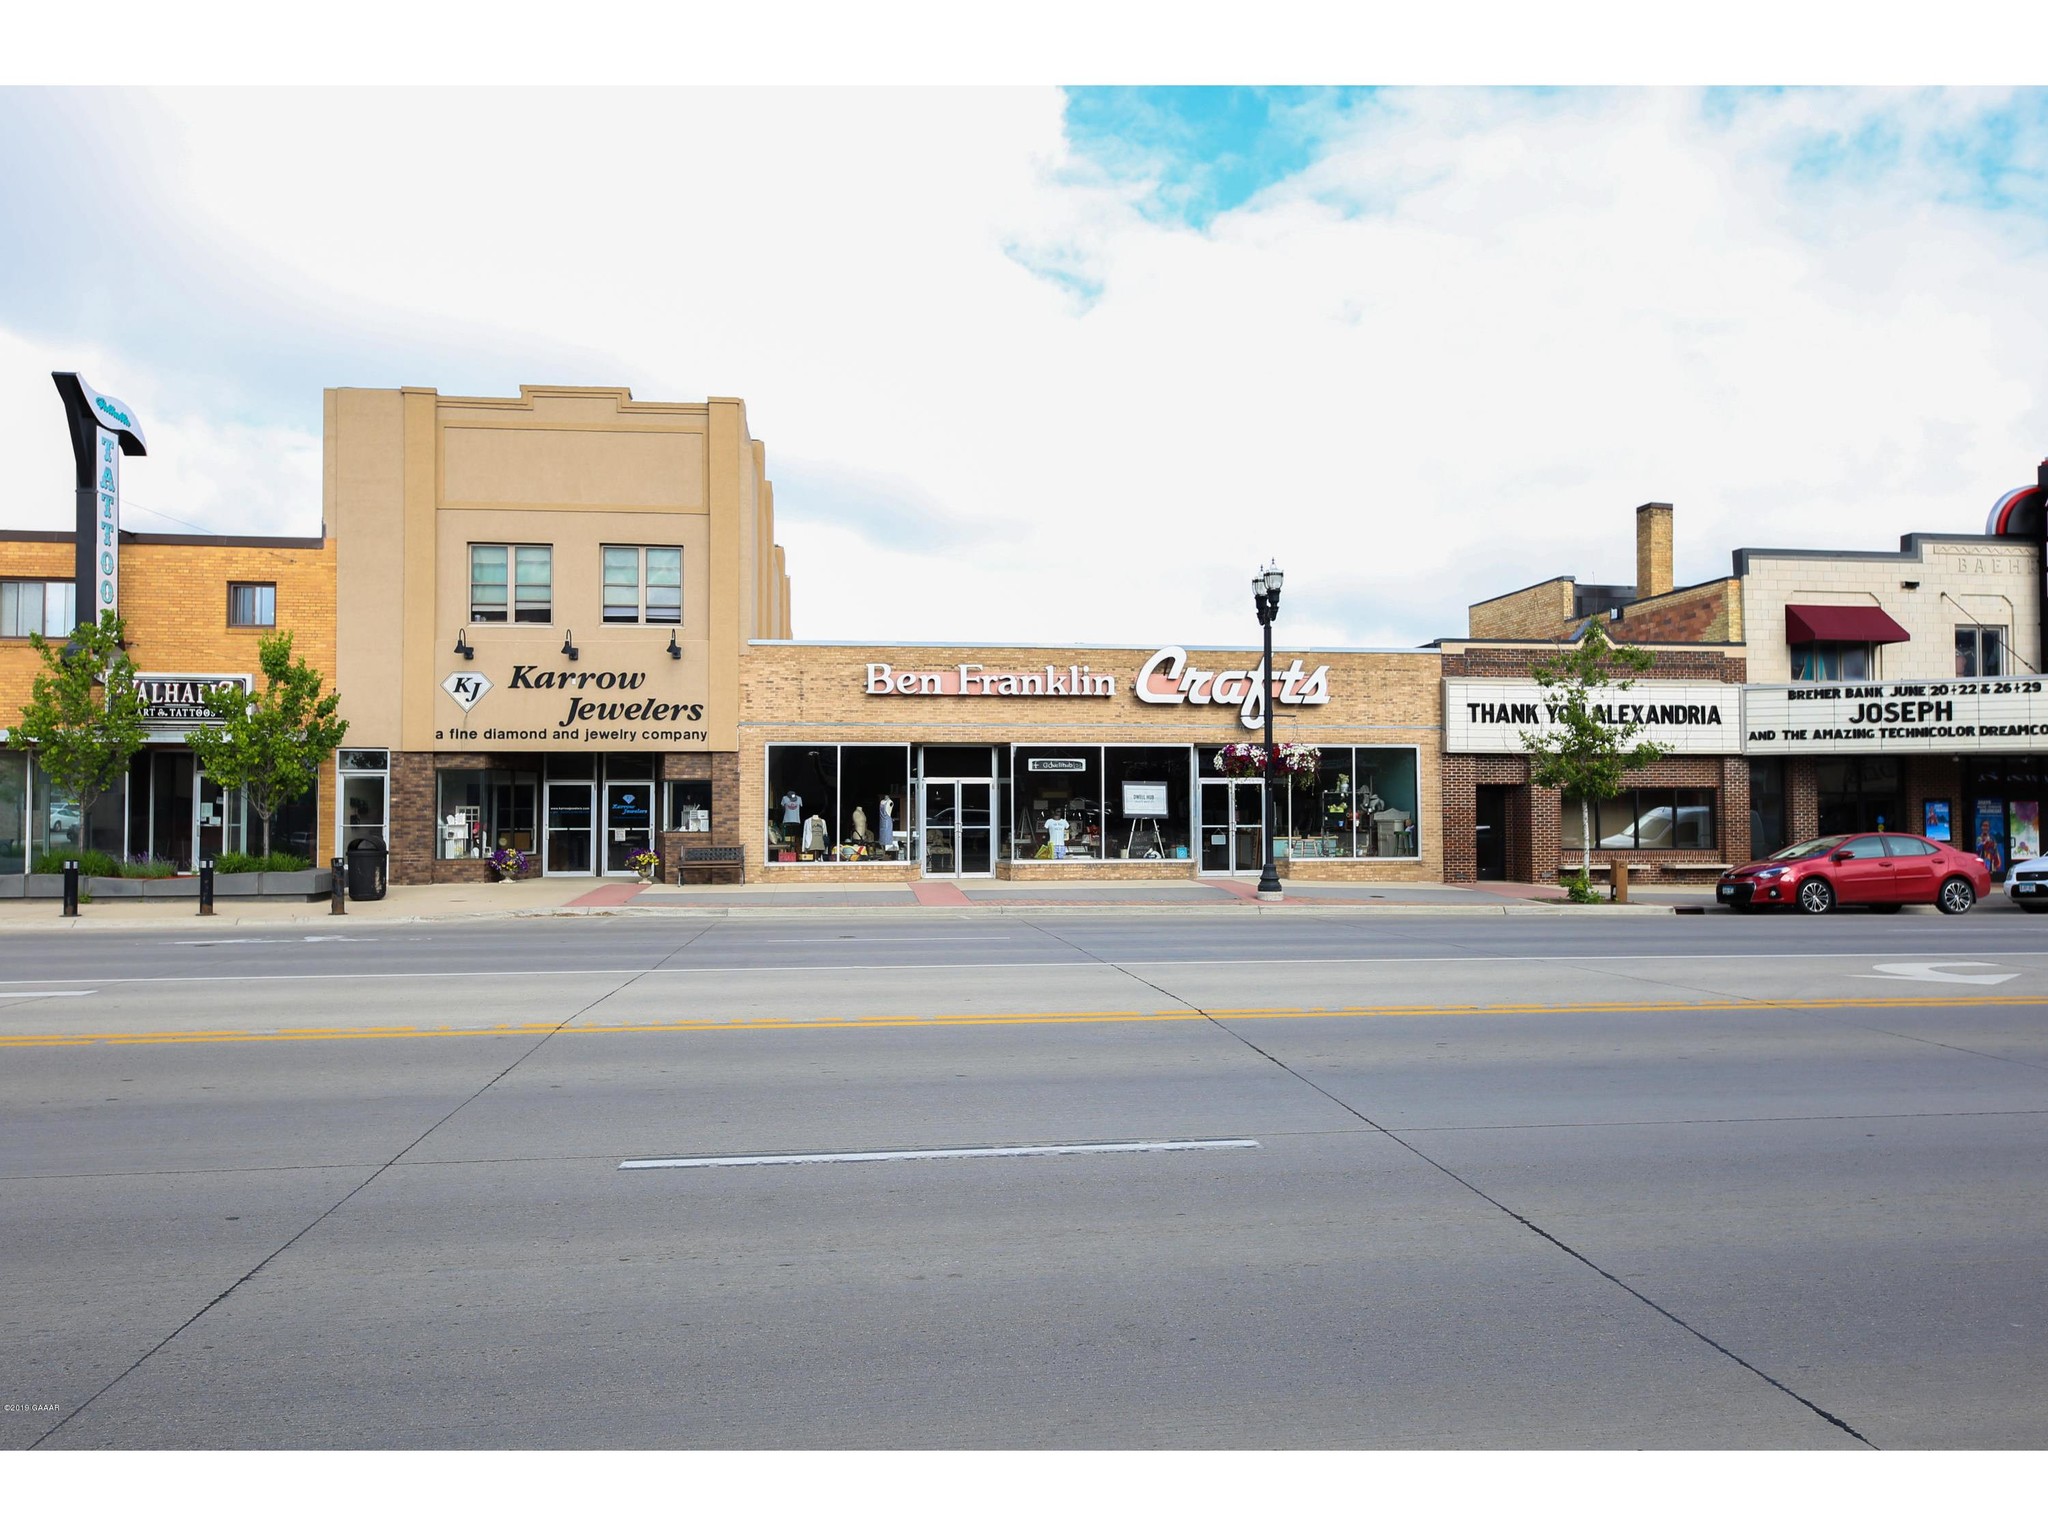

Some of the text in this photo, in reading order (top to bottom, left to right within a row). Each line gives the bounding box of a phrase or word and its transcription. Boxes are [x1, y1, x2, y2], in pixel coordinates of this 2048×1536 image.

[100, 436, 116, 605] TATTOO
[453, 677, 482, 703] KJ
[508, 665, 646, 690] Karrow
[865, 663, 1117, 697] Ben Franklin
[1135, 645, 1331, 730] Crafts
[1788, 688, 1841, 700] BREMER
[1845, 686, 1883, 698] BANK
[1890, 685, 1926, 697] JUNE
[559, 697, 704, 727] Jewelers
[1467, 703, 1722, 725] THANK YO ALEXANDRIA
[1848, 701, 1953, 724] JOSEPH
[435, 732, 444, 740] a
[484, 728, 547, 740] diamond
[553, 728, 579, 740] and
[584, 728, 637, 742] jewelry
[642, 731, 708, 743] company
[1749, 730, 1776, 741] AND
[1782, 730, 1807, 740] THE
[1813, 728, 1875, 740] AMAZING
[1880, 725, 1976, 739] TECHNICOLOR
